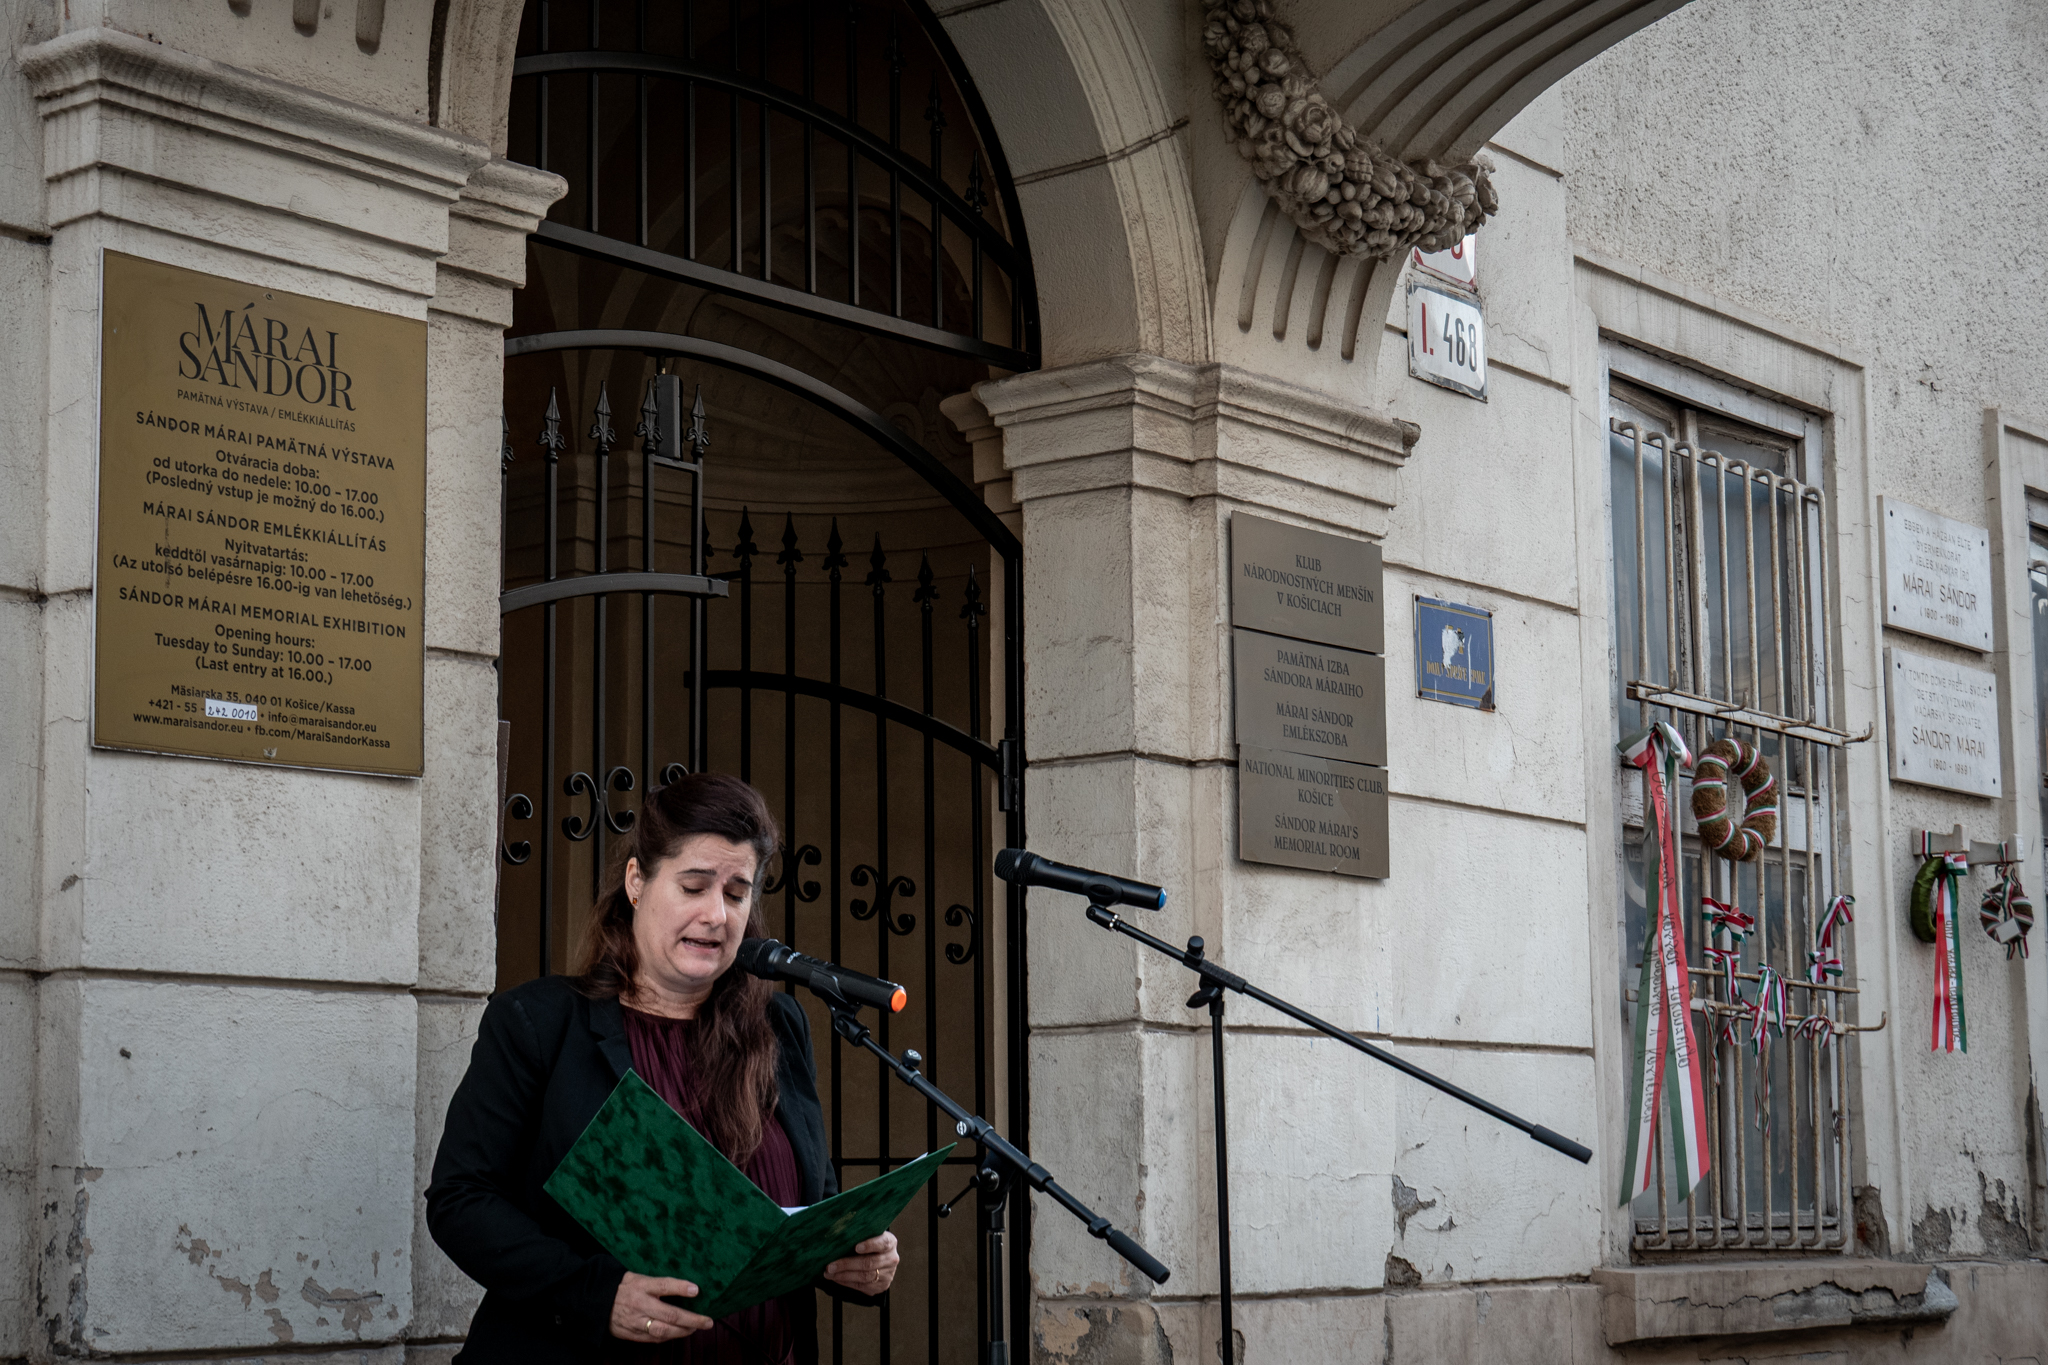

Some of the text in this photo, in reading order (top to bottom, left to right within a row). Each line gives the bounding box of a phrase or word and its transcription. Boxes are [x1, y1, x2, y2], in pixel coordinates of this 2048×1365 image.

[195, 302, 339, 370] MÁRAI
[1443, 313, 1477, 372] 468
[179, 330, 356, 411] SÁNDOR
[178, 389, 223, 407] PAMÄTNÁ
[226, 399, 268, 416] VÝSTAVA
[279, 409, 355, 432] EMLÉKKIÁLLÍTÁS
[137, 411, 394, 470] SÁNDOR MÁRAI PAMÄTNÁ VÝSTAVA
[216, 450, 319, 479] Otváracia doba:
[146, 471, 384, 523] (Posledný vstup je možný do 16.00.)
[153, 457, 170, 469] od
[175, 461, 217, 478] utorka
[222, 467, 239, 481] do
[244, 473, 290, 490] nedele:
[295, 480, 331, 497] 10.00
[346, 489, 378, 505] 17.00
[143, 501, 386, 552] MÁRAI SÁNDOR EMLÉKKIÁLLÍTÁS
[155, 543, 206, 563] keddtől
[211, 553, 286, 577] vasárnapig:
[290, 565, 326, 581] 10.00
[341, 572, 374, 588] 17.00
[225, 538, 308, 562] Nyitvatartás:
[1296, 554, 1321, 572] KLUB
[113, 554, 412, 610] (Az utolsó belépésre 16.00-ig van lehetőség.)
[1244, 562, 1373, 603] NÁRODNOSTNÝCH MENŠÍN
[1903, 572, 1977, 612] MÁRAI SÁNDOR
[119, 587, 405, 638] SÁNDOR MÁRAI MEMORIAL EXHIBITION
[1277, 591, 1341, 617] V KOŠICIACH
[215, 624, 315, 648] Opening hours:
[155, 633, 209, 654] Tuesday
[214, 641, 227, 654] to
[232, 643, 283, 663] Sunday:
[288, 650, 324, 666] 10.00
[339, 657, 372, 672] 17.00
[1277, 650, 1349, 676] PAMÄTNÁ IZBA
[196, 656, 332, 685] (Last entry at 16.00.)
[1264, 667, 1363, 698] SÁNDORA MÁRAIHO
[149, 699, 173, 710] +421
[185, 702, 197, 713] 55
[171, 684, 355, 715] Mäsiarska 35, 040 01 Košice/Kassa
[207, 706, 256, 720] 242 0010
[1276, 702, 1353, 727] MÁRAI SÁNDOR
[133, 714, 390, 748] www.maraisandor.eu fb.com/MaraiSandorKassa
[268, 711, 376, 732] info@maraisandor.eu
[1283, 724, 1348, 747] EMLÉKSZOBA
[1912, 724, 1986, 759] SÁNDOR MÁRAI
[1245, 759, 1385, 796] NATIONAL MINORITIES CLUB,
[1298, 788, 1333, 807] KOŠICE
[1275, 813, 1358, 839] SÁNDOR MÁRAI'S
[1274, 836, 1360, 860] MEMORIAL ROOM
